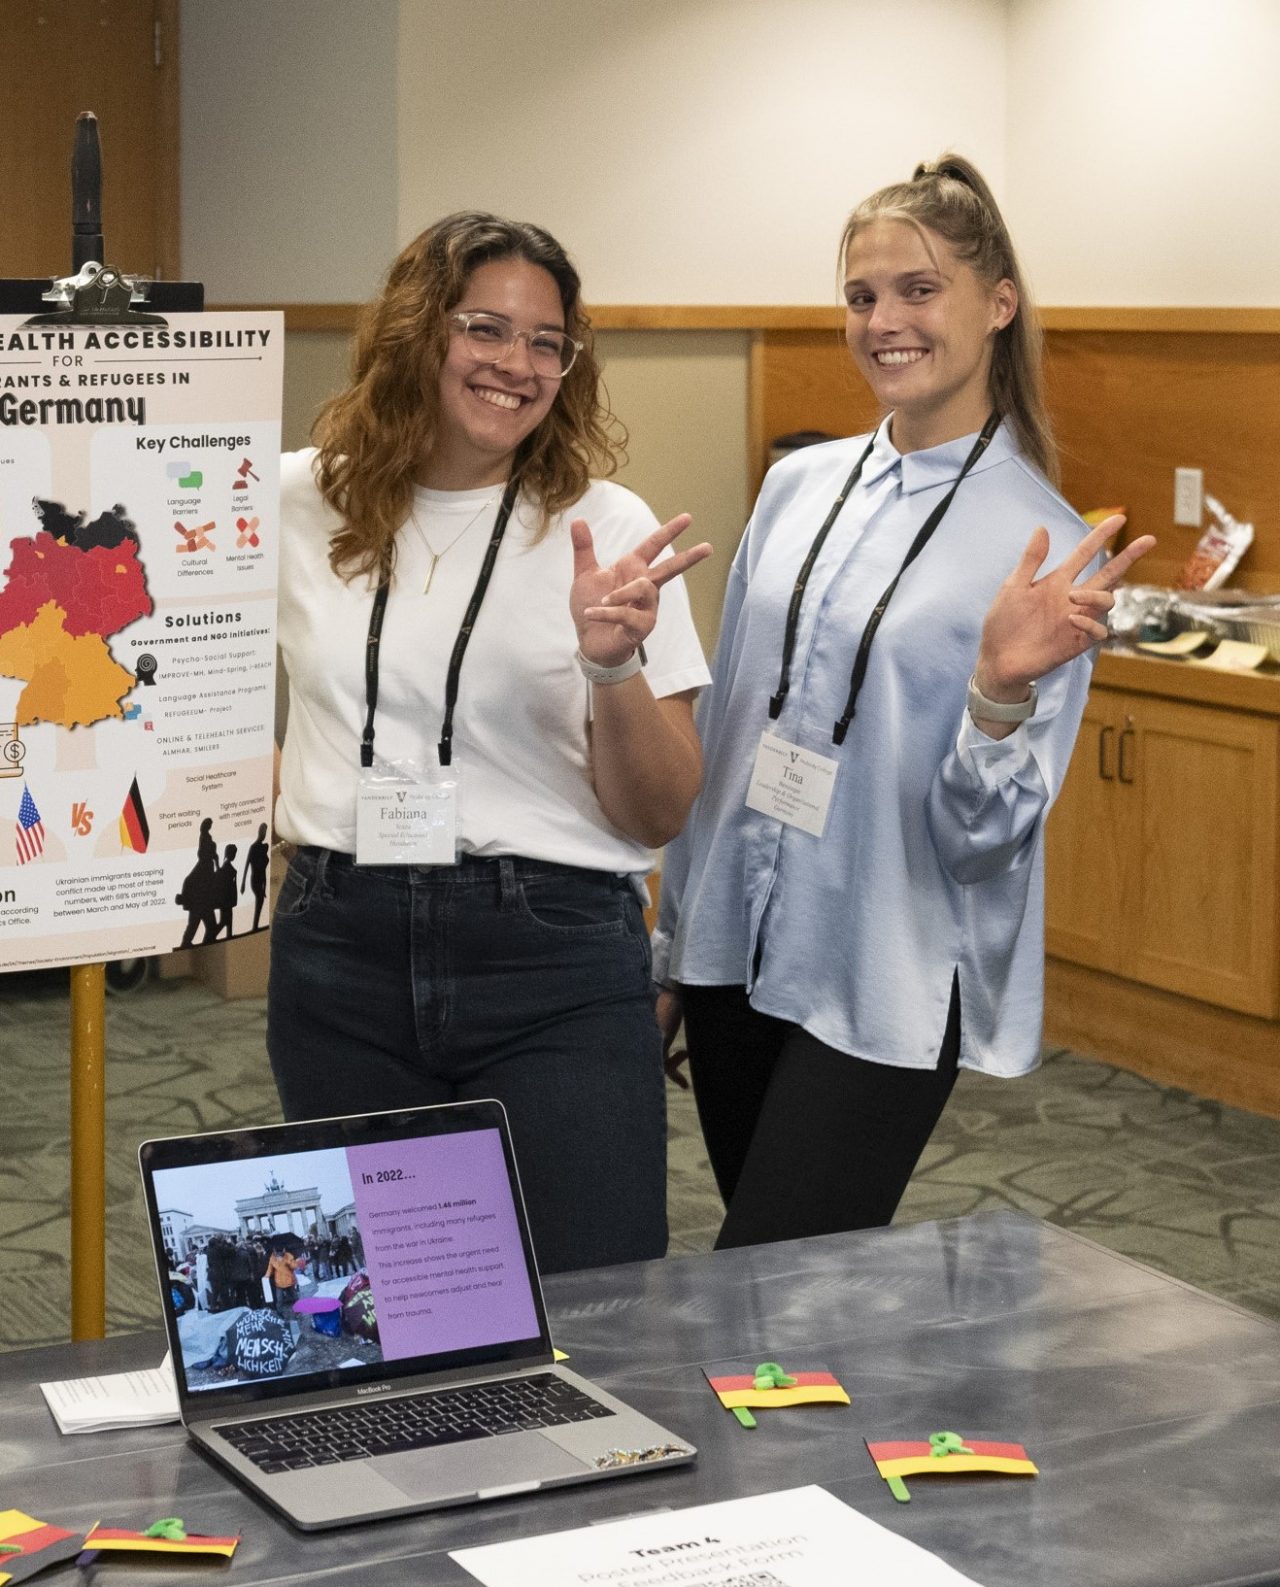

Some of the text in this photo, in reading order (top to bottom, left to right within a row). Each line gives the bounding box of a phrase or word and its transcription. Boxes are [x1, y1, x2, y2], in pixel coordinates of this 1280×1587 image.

[85, 330, 270, 349] ACCESSIBILITY
[53, 356, 83, 367] FOR
[59, 375, 70, 386] &
[79, 373, 165, 386] REFUGEES
[172, 372, 190, 384] IN
[136, 435, 251, 453] Key Challenges
[167, 498, 201, 506] Language
[233, 495, 249, 503] Legal
[182, 558, 207, 567] Cultural
[178, 569, 213, 577] Differences
[165, 611, 242, 628] Solutions
[131, 627, 270, 647] Government and NGO Initiatives:
[159, 689, 235, 703] Language Assistance
[210, 705, 232, 715] Project
[157, 728, 234, 744] ONLINE & TELEHEALTH
[790, 751, 800, 763] V
[784, 765, 803, 784] Tina
[72, 802, 94, 836] VS
[159, 809, 200, 820] Short waiting
[380, 807, 427, 819] Fabiana
[168, 821, 192, 830] periods
[56, 869, 164, 885] Ukrainian immigrants escaping
[56, 887, 82, 896] conflict
[99, 893, 114, 901] with
[1, 906, 38, 916] according
[53, 909, 85, 917] between
[86, 905, 109, 913] March
[8, 917, 31, 926] Office.
[362, 1169, 416, 1185] In 2022...
[369, 1210, 400, 1219] Germany
[402, 1203, 437, 1214] welcomed
[446, 1252, 457, 1260] the
[237, 1320, 266, 1339] MEHR
[357, 1385, 381, 1395] MacBook
[629, 1540, 700, 1557] Team
